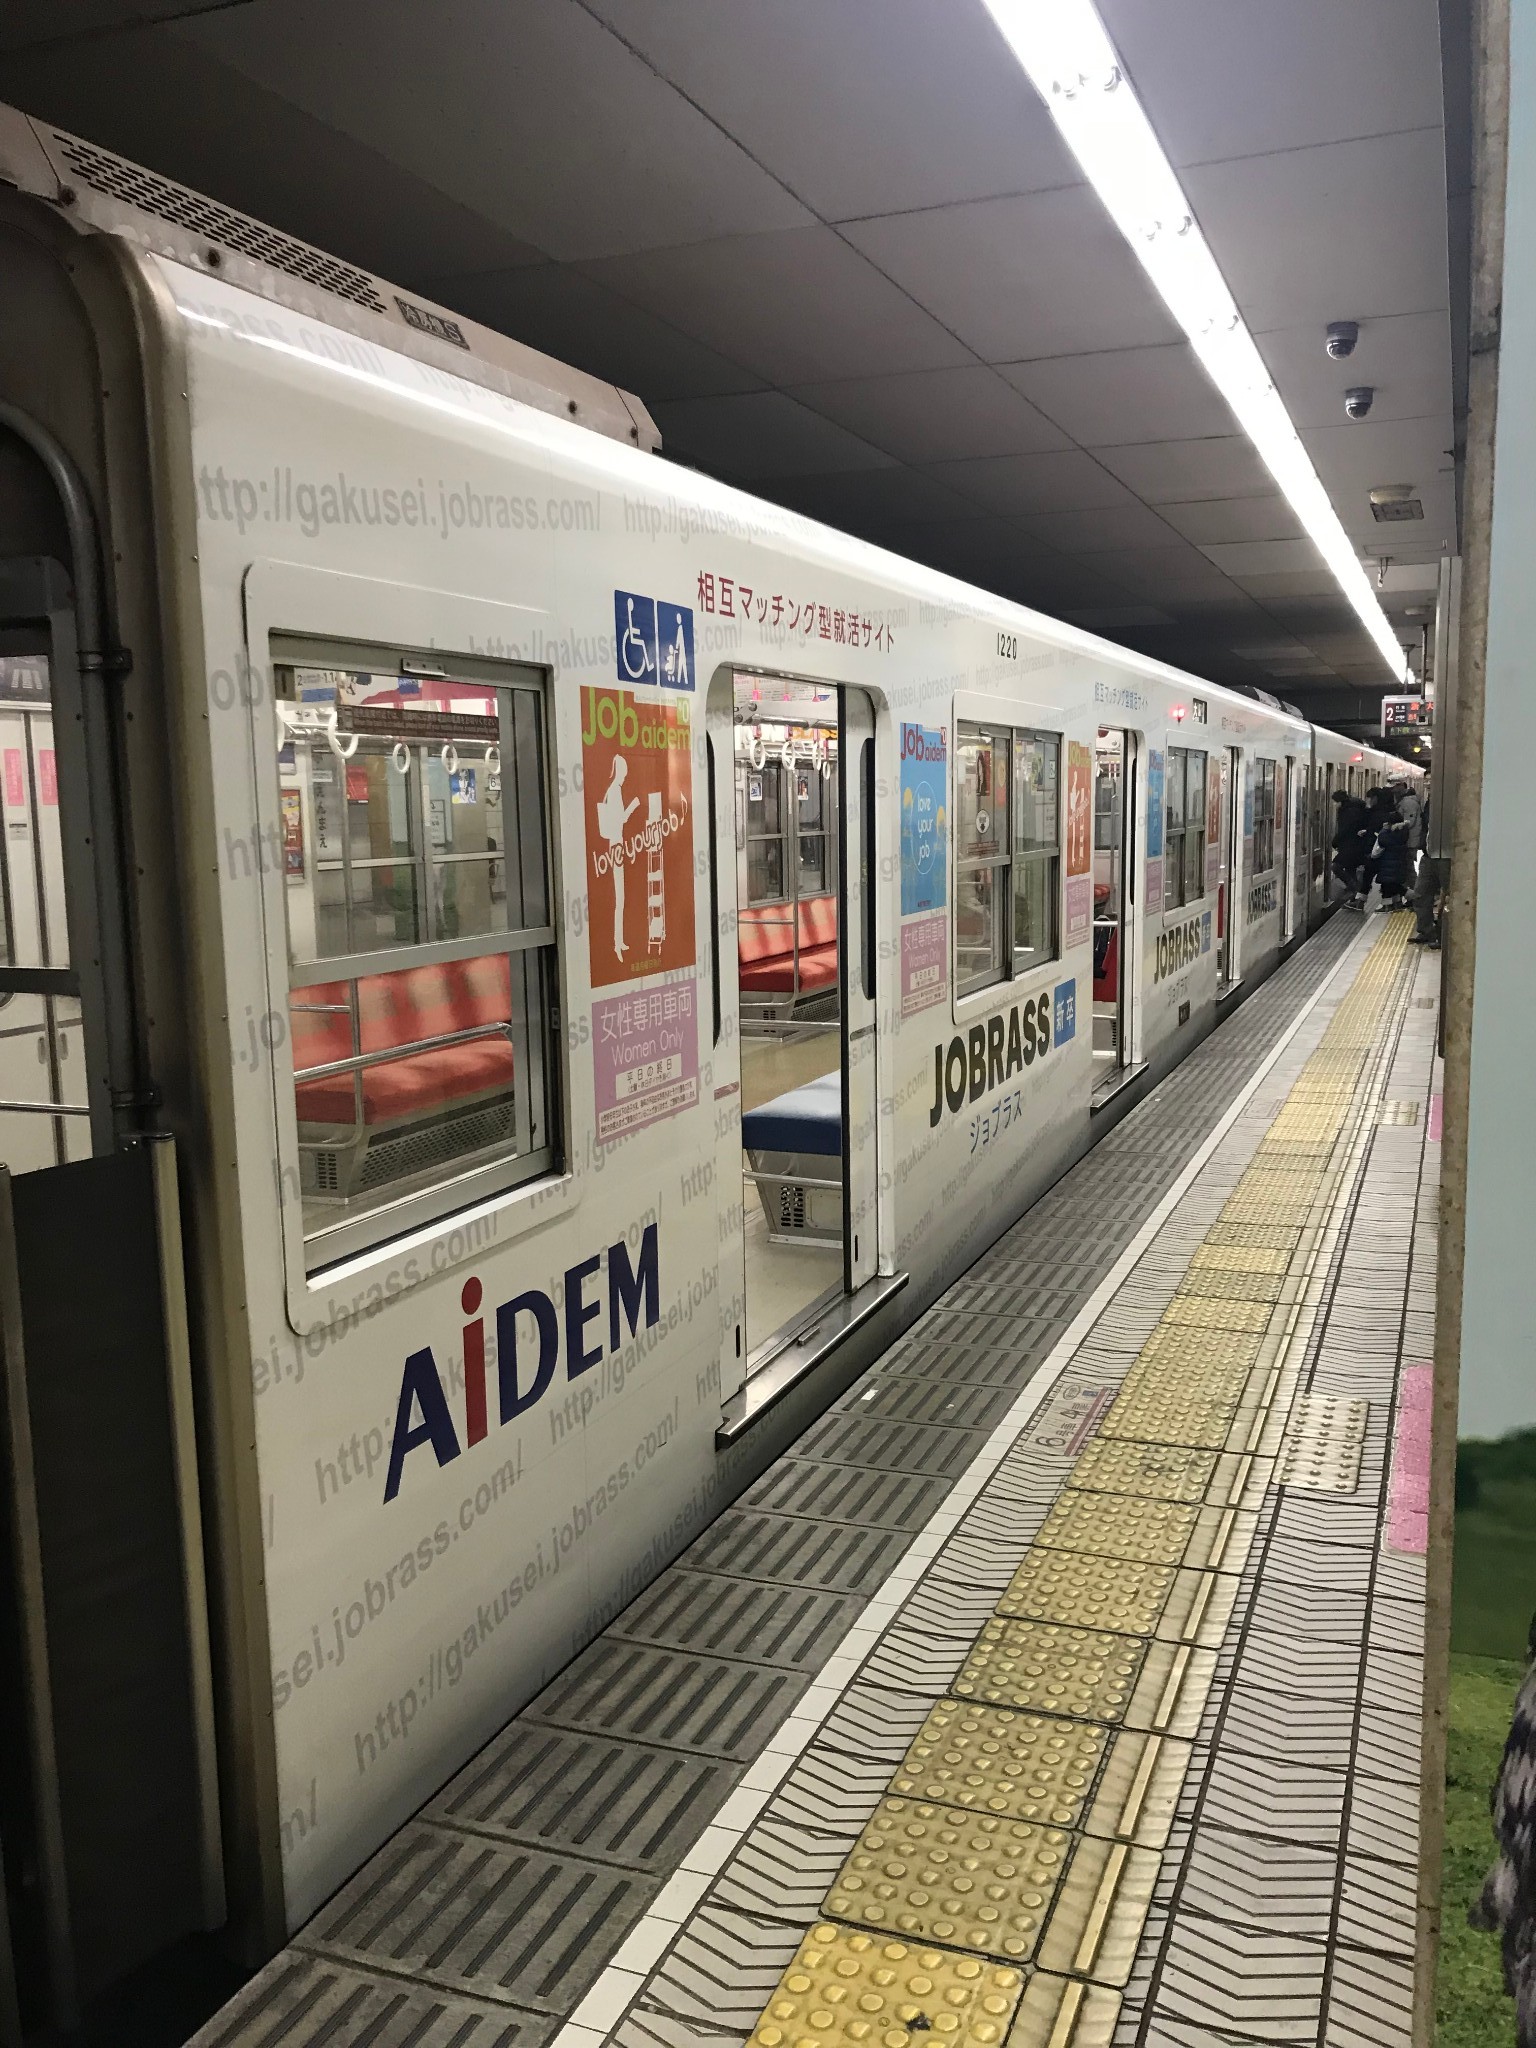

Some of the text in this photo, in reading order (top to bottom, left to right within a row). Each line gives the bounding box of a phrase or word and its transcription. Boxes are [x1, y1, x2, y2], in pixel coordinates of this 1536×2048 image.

[697, 570, 895, 653] 相互マッチング型就活サイト
[996, 631, 1018, 660] 1220
[582, 686, 692, 751] Job aidem
[901, 722, 925, 762] Job
[1386, 707, 1394, 721] 2
[593, 808, 679, 878] love your job
[1154, 916, 1201, 985] JOBRASS
[600, 985, 692, 1044] 女性専用車両
[611, 1026, 684, 1067] Women Only
[929, 991, 1051, 1129] JOBRASS
[382, 1221, 660, 1506] AiDEM
